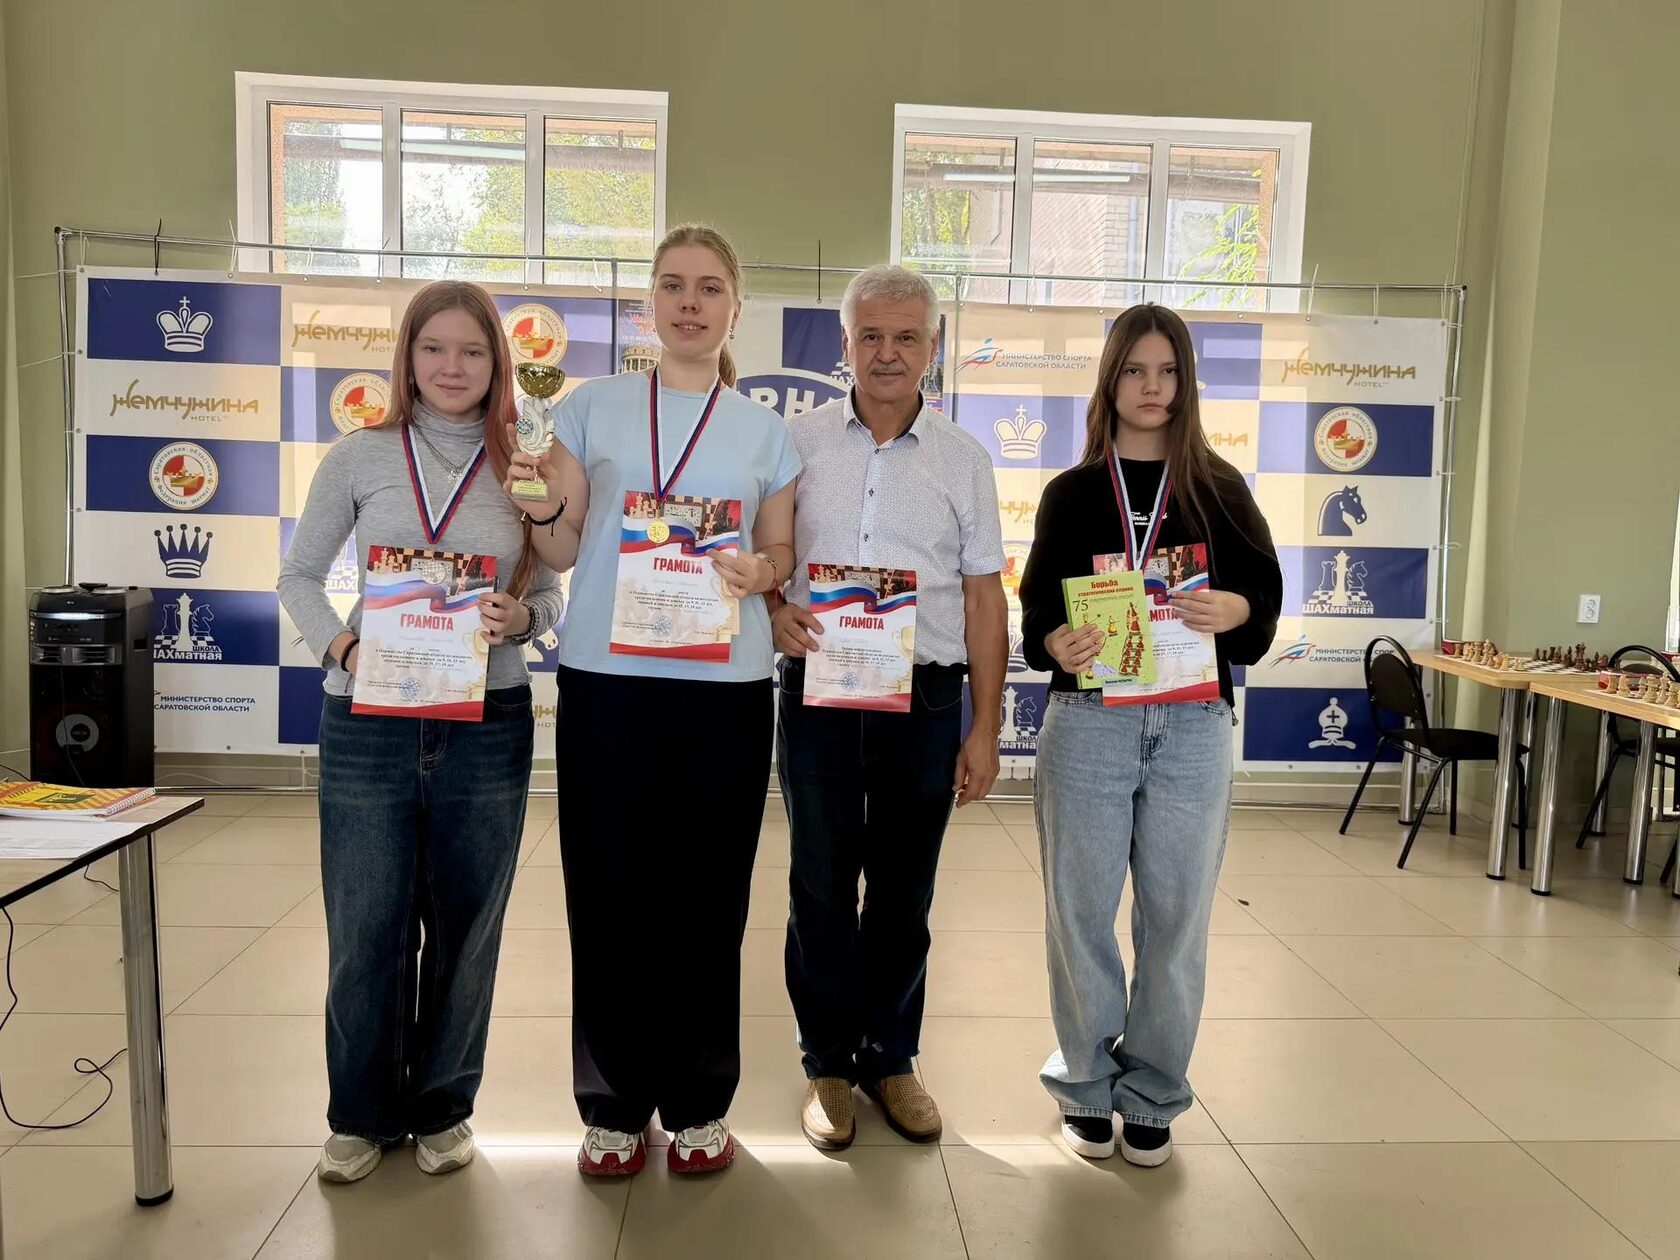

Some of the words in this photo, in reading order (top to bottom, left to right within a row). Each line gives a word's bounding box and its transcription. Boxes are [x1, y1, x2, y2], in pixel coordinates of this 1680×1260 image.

[1002, 353, 1062, 361] МИНИСТЕРСТВО
[996, 361, 1049, 369] САРАТОВСКОЙ
[153, 447, 186, 475] Саратовская
[189, 448, 213, 476] областная
[653, 557, 703, 575] ГРАМОТА
[1072, 598, 1089, 612] 75
[1302, 603, 1374, 615] ШАХматная
[1148, 607, 1179, 622] МОТА
[400, 613, 454, 631] ГРАМОТА
[839, 616, 885, 630] ГРАМОТА
[1309, 655, 1361, 663] САРАТОВСКОЙ
[160, 695, 223, 703] МИНИСТЕРСТВО
[224, 696, 256, 704] СПОРТА
[154, 703, 211, 711] САРАТОВСКОЙ
